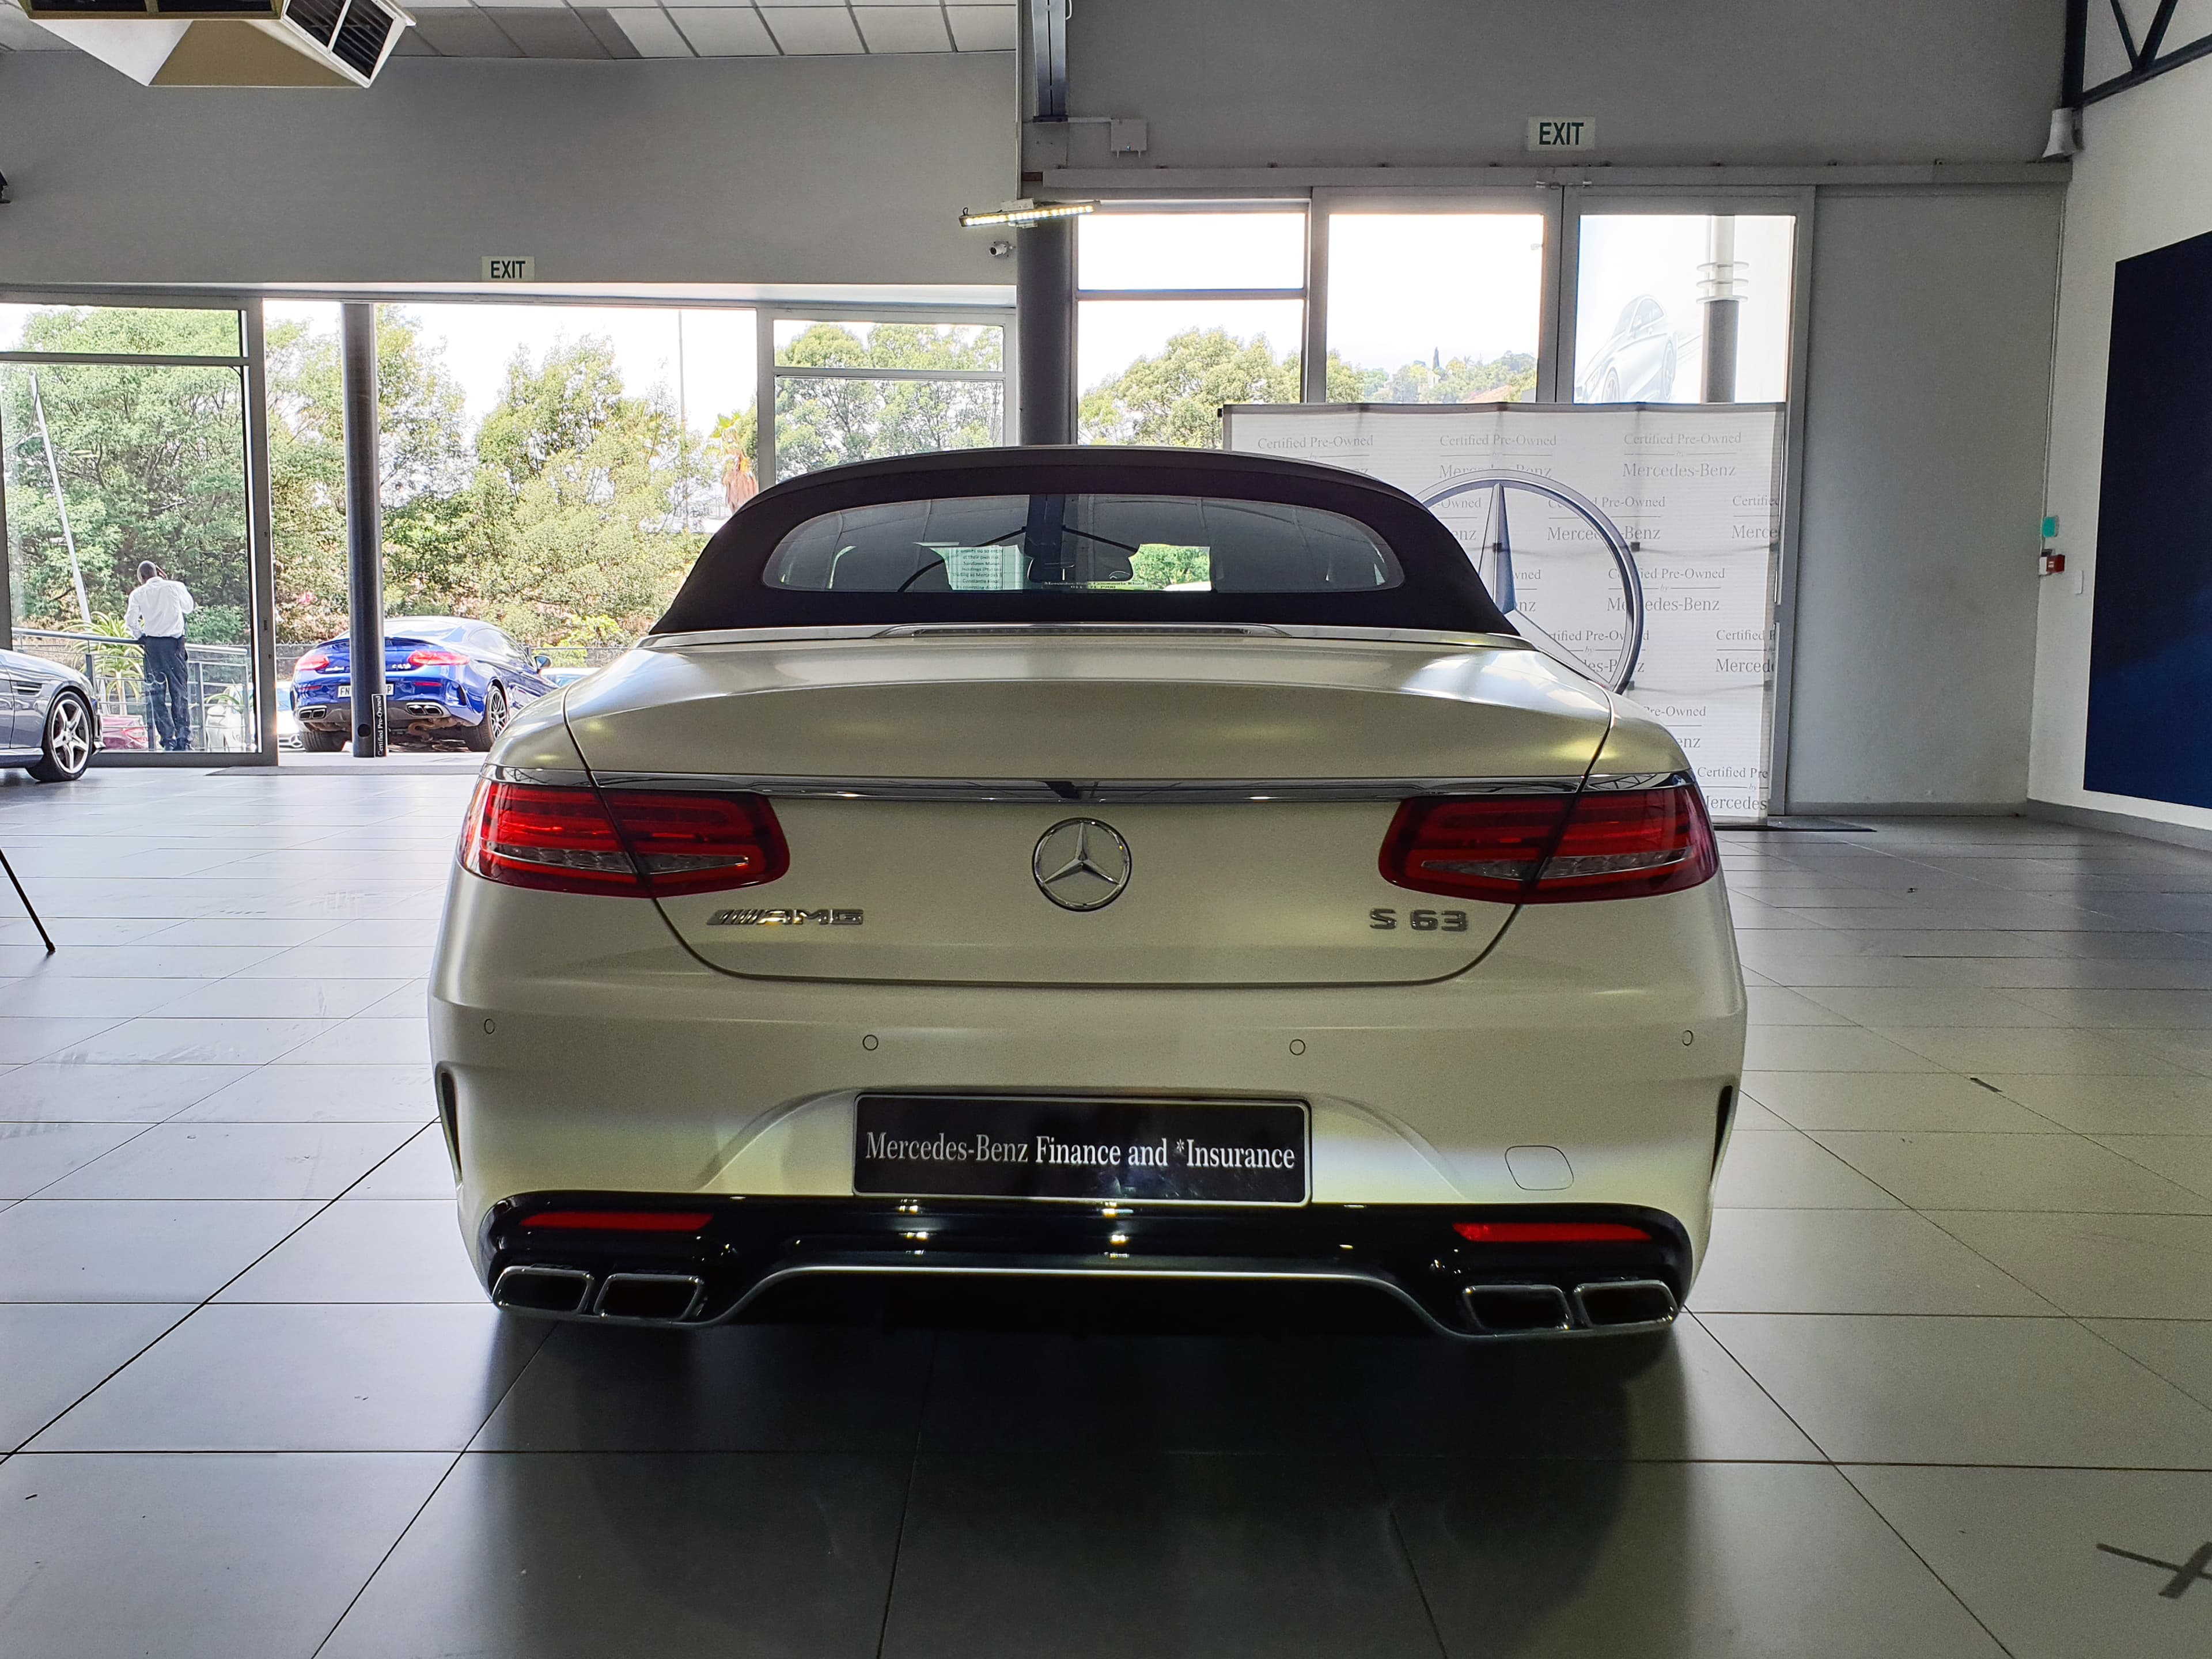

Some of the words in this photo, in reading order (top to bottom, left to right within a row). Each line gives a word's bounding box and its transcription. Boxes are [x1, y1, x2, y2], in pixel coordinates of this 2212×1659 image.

[1539, 122, 1584, 145] EXIT
[491, 260, 525, 278] EXIT
[1257, 437, 1306, 449] Certified
[1310, 435, 1373, 448] Pre-Owned
[1440, 434, 1489, 446] Certified
[1493, 434, 1557, 446] Pre-Owned
[1624, 433, 1673, 445] Certified
[1677, 433, 1741, 445] Pre-Owned
[1622, 463, 1736, 477] Mercedes-Benz
[1601, 497, 1665, 507] Pre-Owned
[1547, 526, 1661, 540] Merce-Benz
[1661, 567, 1725, 579] Pre-Owned
[1697, 767, 1746, 778] Certified
[1369, 908, 1397, 930] S
[1410, 909, 1468, 932] 63
[866, 1131, 1028, 1162] Mercedes-Benz
[1035, 1135, 1121, 1165] Finance
[1128, 1138, 1168, 1167] and
